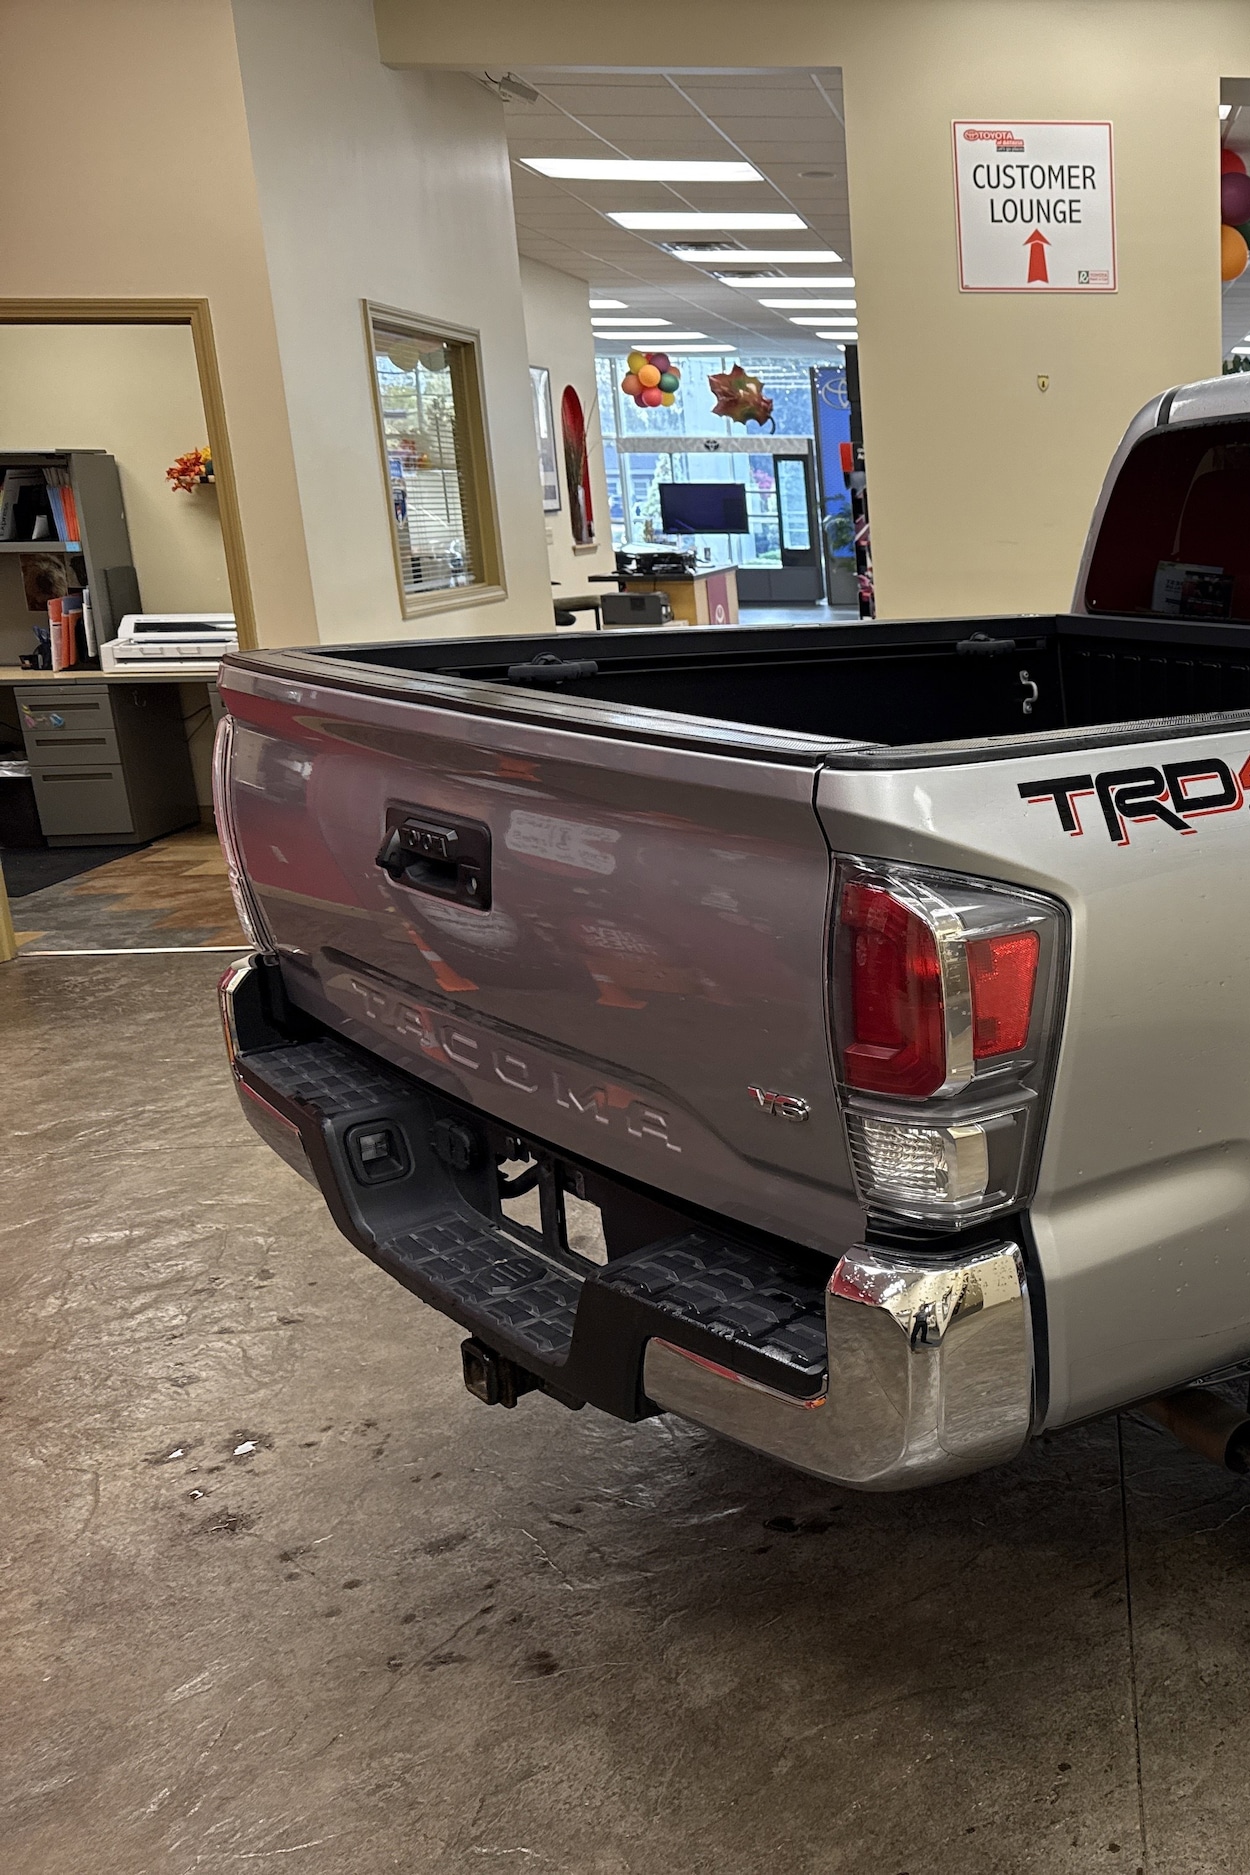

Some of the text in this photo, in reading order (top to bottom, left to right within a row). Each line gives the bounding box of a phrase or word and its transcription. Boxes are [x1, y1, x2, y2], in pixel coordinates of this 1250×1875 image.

[978, 131, 1013, 140] TOYOTA
[973, 164, 1096, 190] CUSTOMER
[990, 198, 1082, 224] LOUNGE
[1017, 757, 1244, 847] TRD
[351, 979, 682, 1152] TACOMA
[747, 1086, 809, 1122] V6
